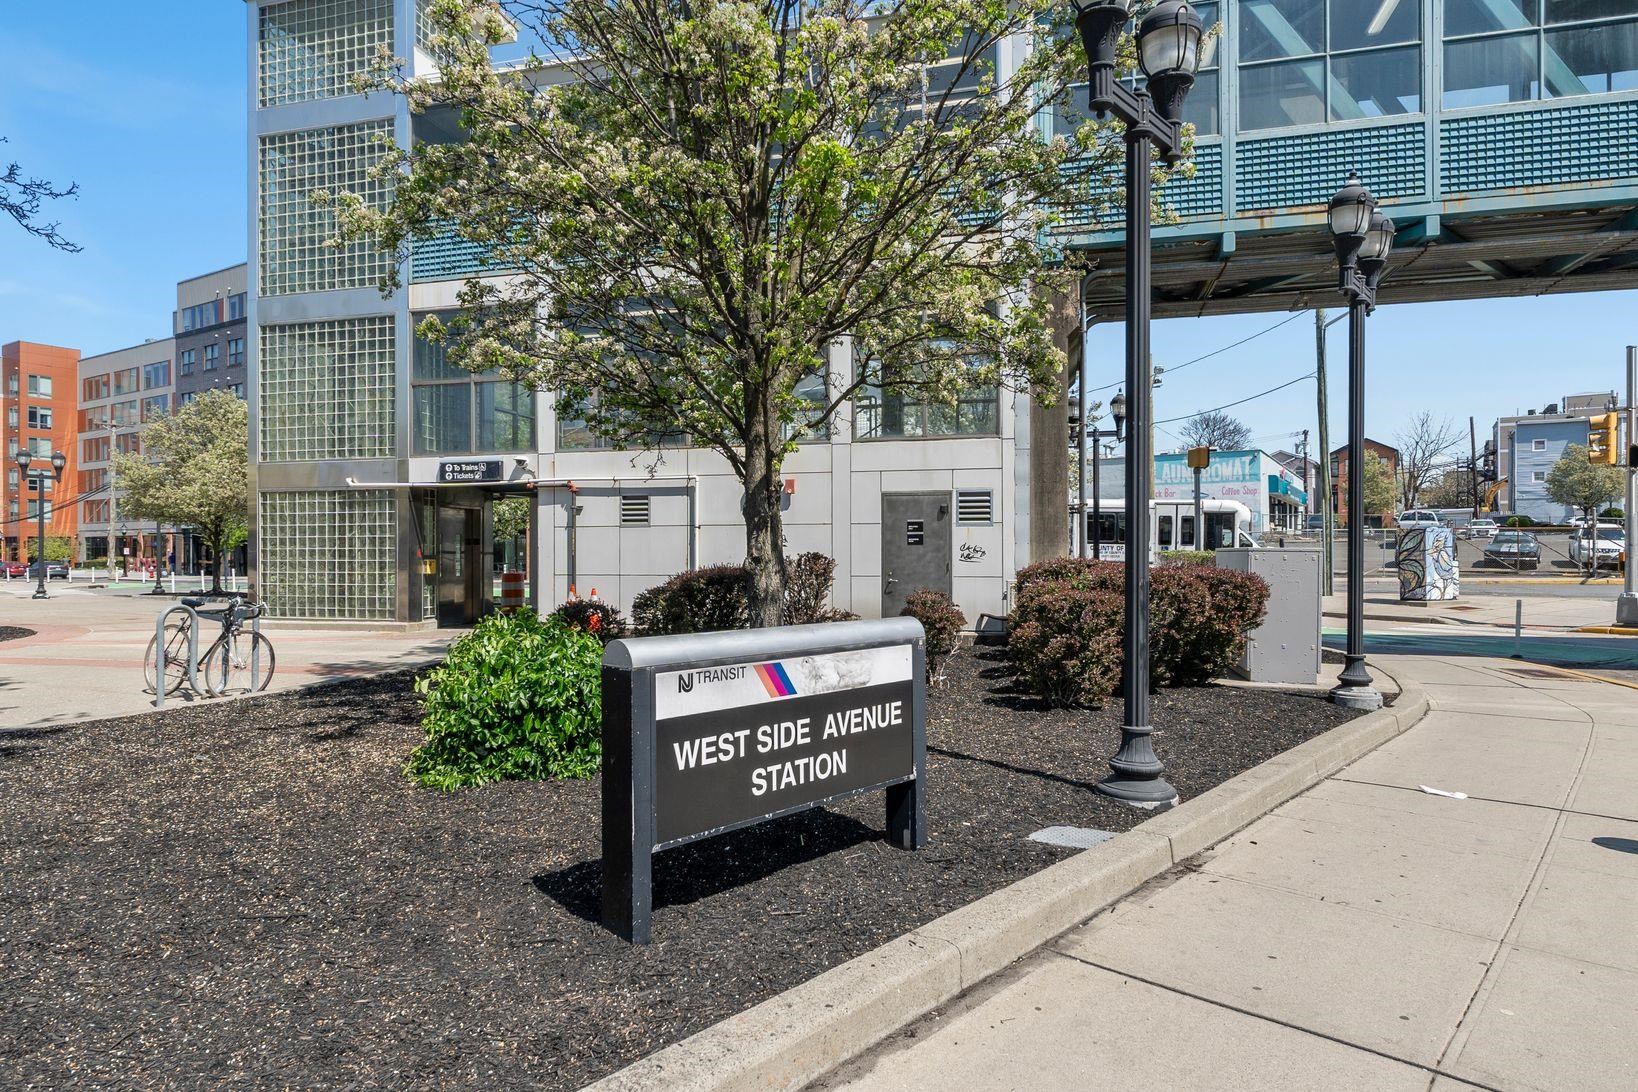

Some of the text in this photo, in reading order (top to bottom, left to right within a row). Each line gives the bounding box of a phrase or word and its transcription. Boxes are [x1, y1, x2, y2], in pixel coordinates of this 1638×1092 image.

[1154, 456, 1252, 483] LAUNROMAT
[1164, 487, 1176, 498] Bar
[1221, 486, 1258, 497] Coffee Shop
[678, 666, 747, 693] NJ TRANSIT
[673, 700, 903, 771] WEST SIDE AVENUE
[751, 748, 847, 797] STATION
